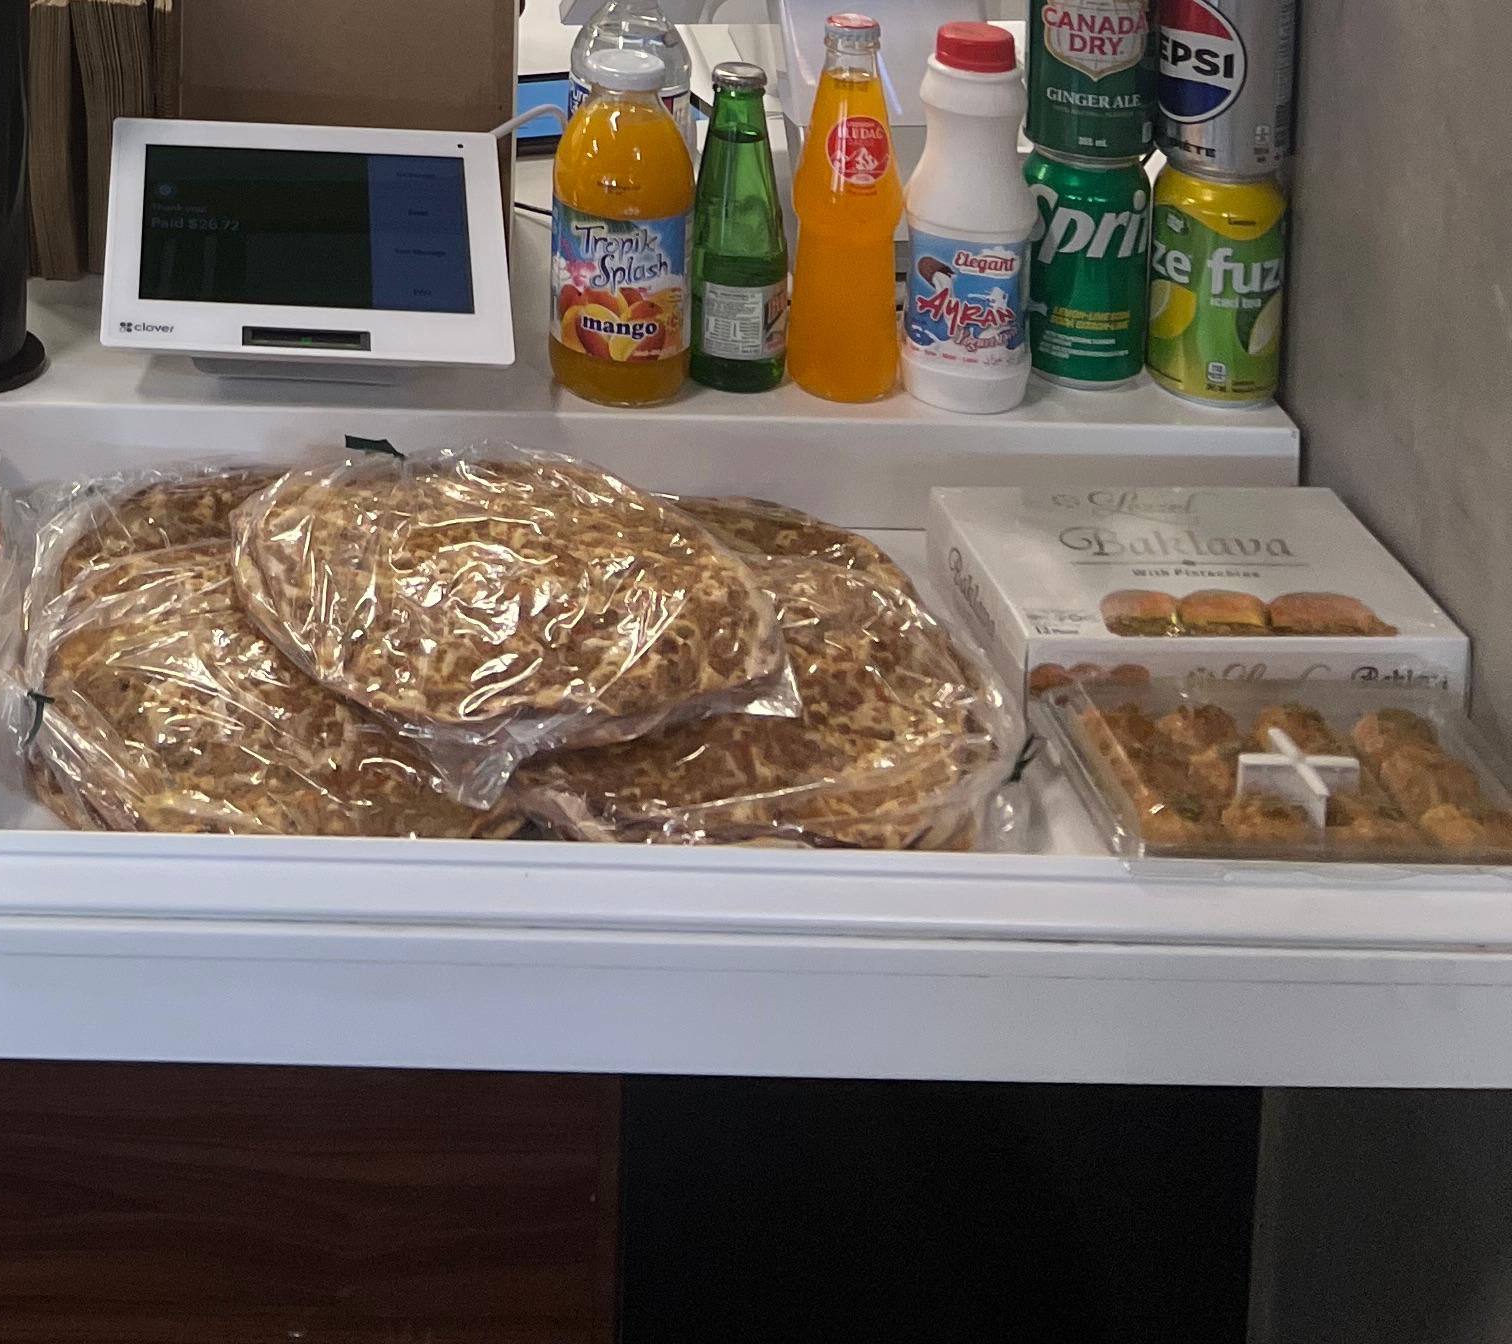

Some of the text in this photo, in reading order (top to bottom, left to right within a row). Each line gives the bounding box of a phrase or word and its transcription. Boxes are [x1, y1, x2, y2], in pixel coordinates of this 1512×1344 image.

[1043, 7, 1148, 35] CANADA
[1069, 33, 1123, 56] DRY
[1159, 31, 1234, 78] EPSI
[1046, 86, 1141, 109] GINGER ALE
[1029, 183, 1149, 265] Spri
[575, 225, 658, 259] Tropik
[591, 253, 669, 295] Splash
[954, 251, 1015, 272] Elegant
[1206, 247, 1281, 294] fuz
[134, 321, 174, 334] clover
[583, 315, 658, 340] mango
